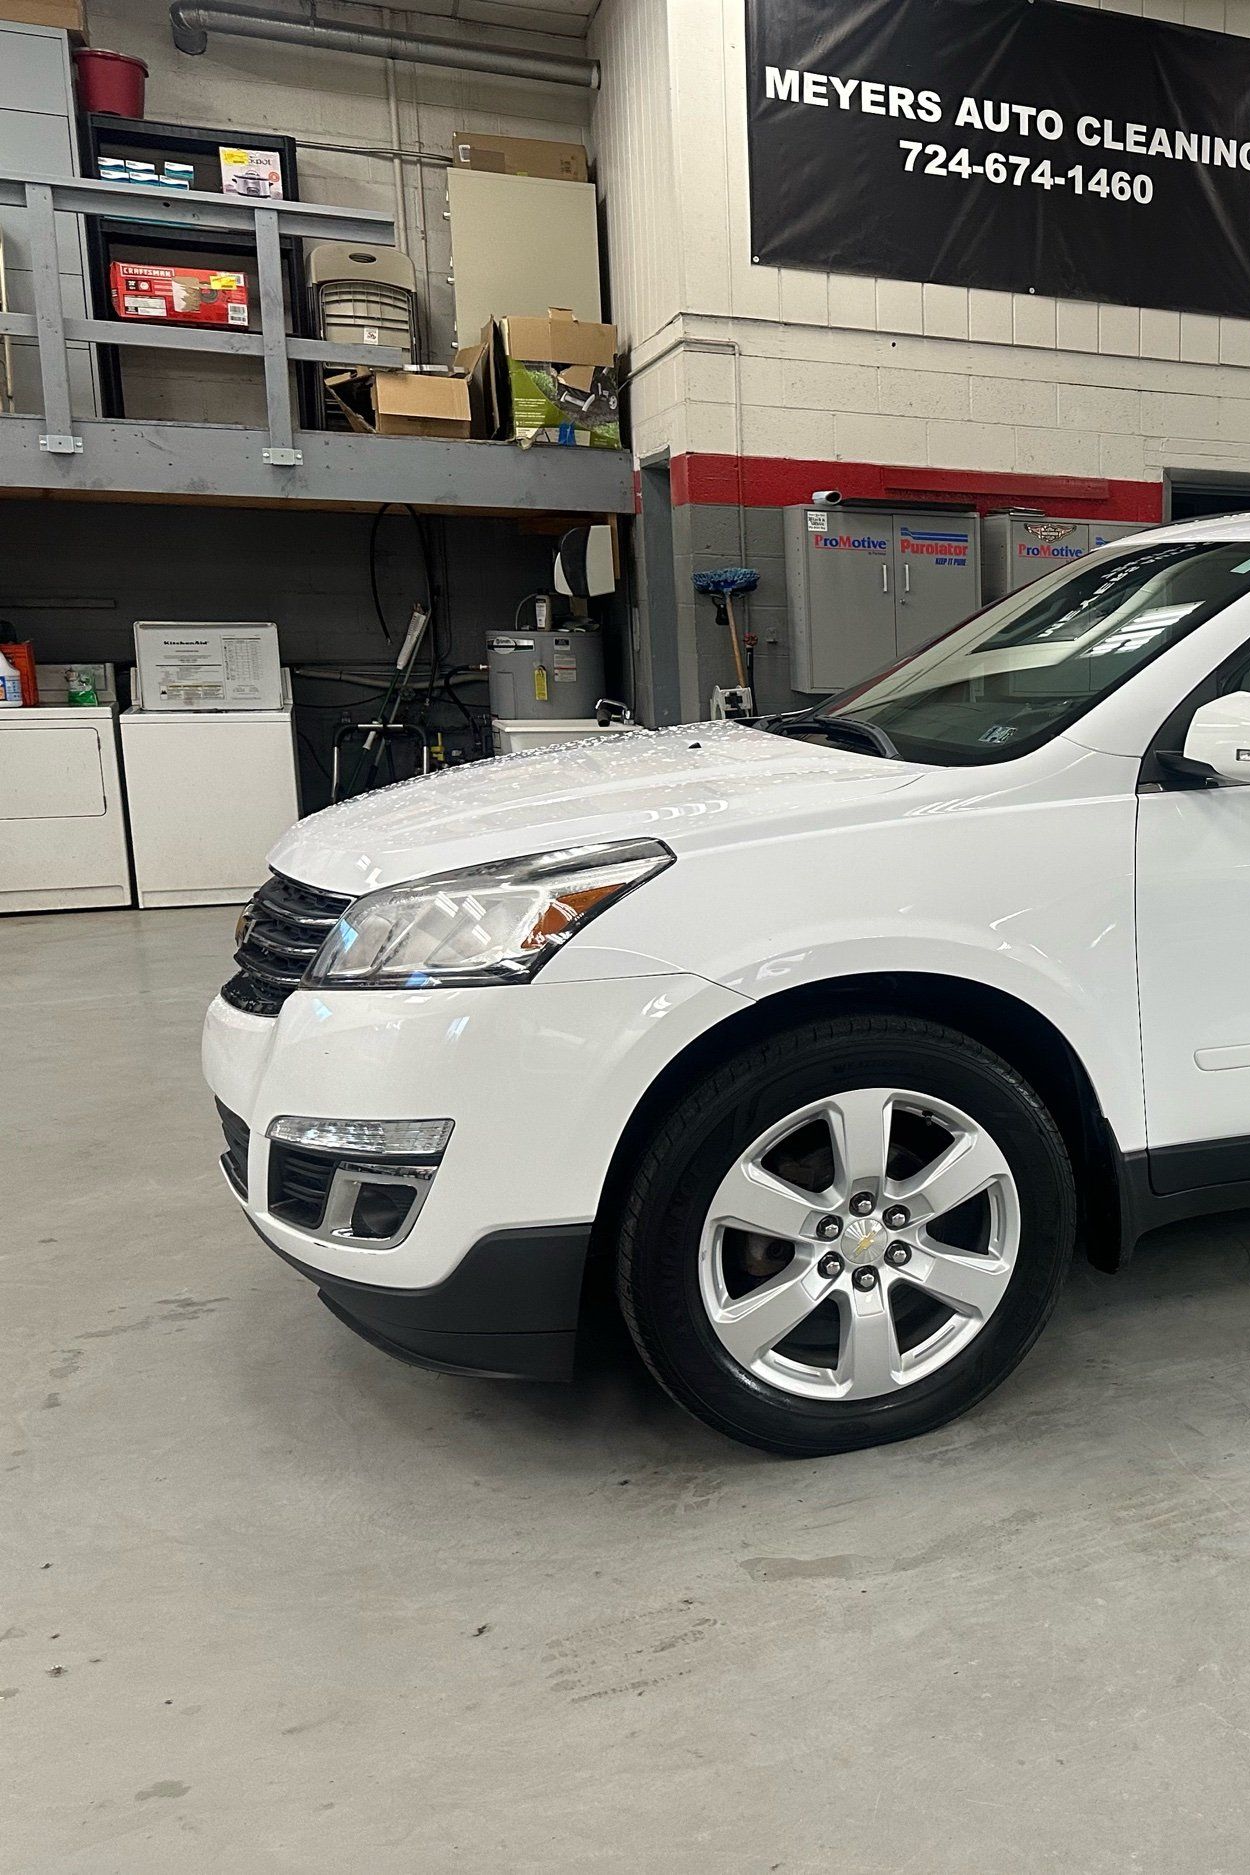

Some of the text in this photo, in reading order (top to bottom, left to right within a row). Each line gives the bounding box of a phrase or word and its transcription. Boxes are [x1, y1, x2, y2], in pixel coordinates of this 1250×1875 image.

[765, 66, 942, 123] MEYERS
[954, 97, 1063, 140] AUTO
[900, 140, 1154, 205] 724-674-1460
[814, 534, 887, 549] ProMotive
[900, 539, 968, 556] Purolator
[1018, 543, 1082, 557] ProMotive
